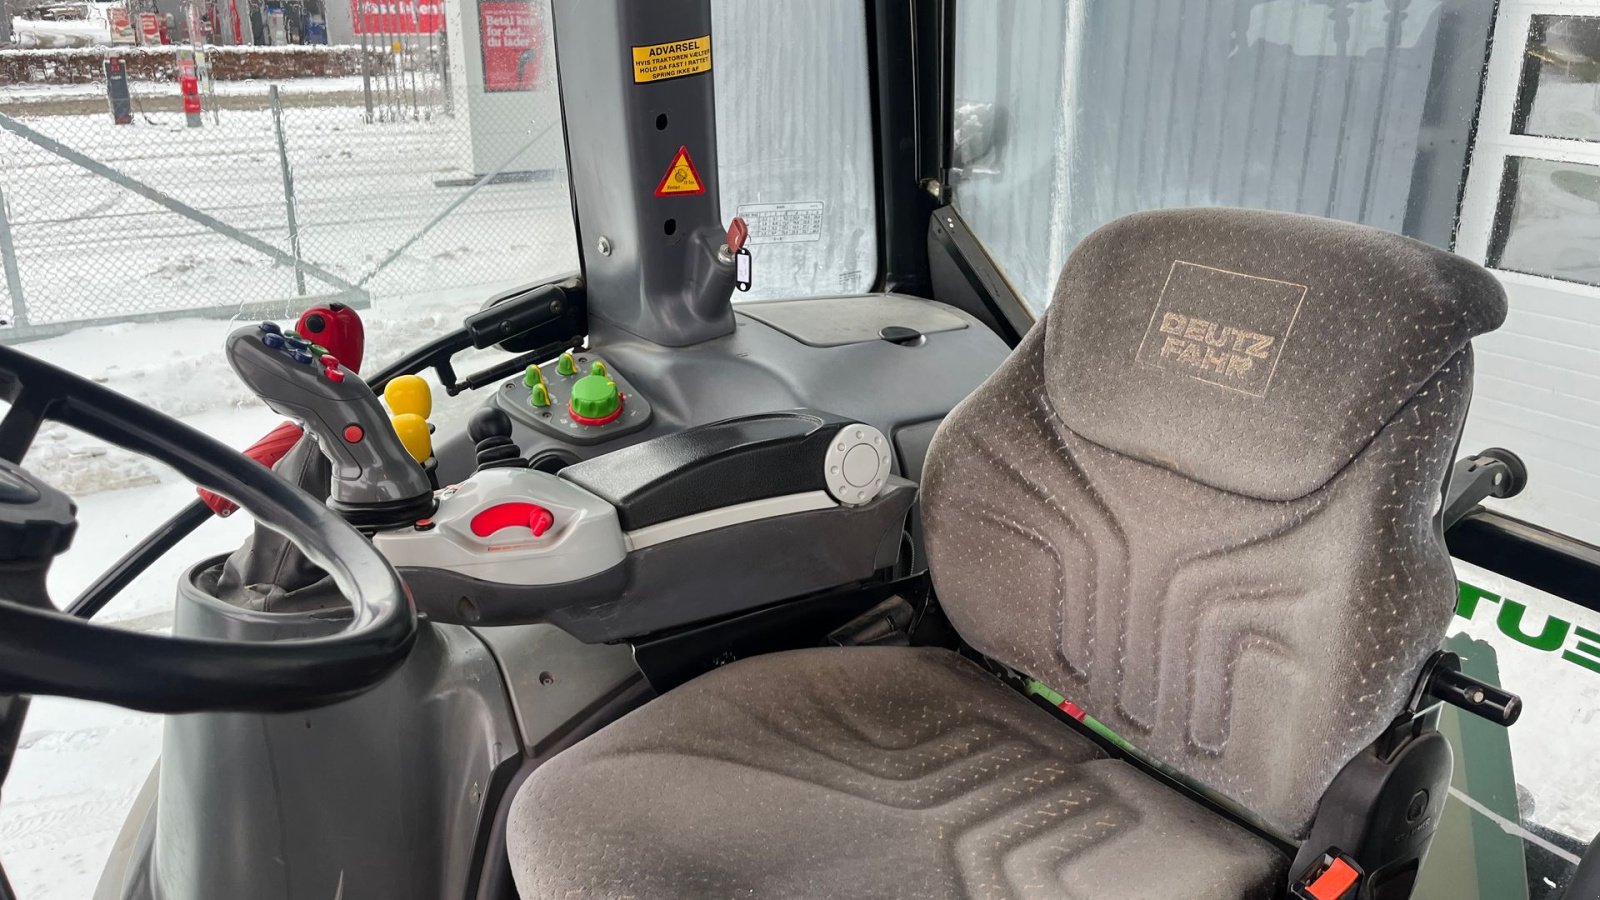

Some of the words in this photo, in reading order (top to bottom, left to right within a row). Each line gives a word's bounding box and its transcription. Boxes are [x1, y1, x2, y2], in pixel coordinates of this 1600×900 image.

[486, 15, 515, 26] Betal
[487, 36, 501, 47] du
[649, 41, 700, 57] ADVARSEL
[635, 59, 651, 67] HVIS
[652, 54, 689, 65] TRAKTOREN
[640, 65, 658, 74] HOLD
[668, 61, 683, 70] FAST
[688, 56, 709, 66] RATTET
[652, 70, 676, 80] SPRING
[676, 67, 691, 75] IKKE
[691, 65, 700, 73] AF
[1160, 311, 1276, 359] DEUTZ
[1160, 336, 1254, 380] FAHR
